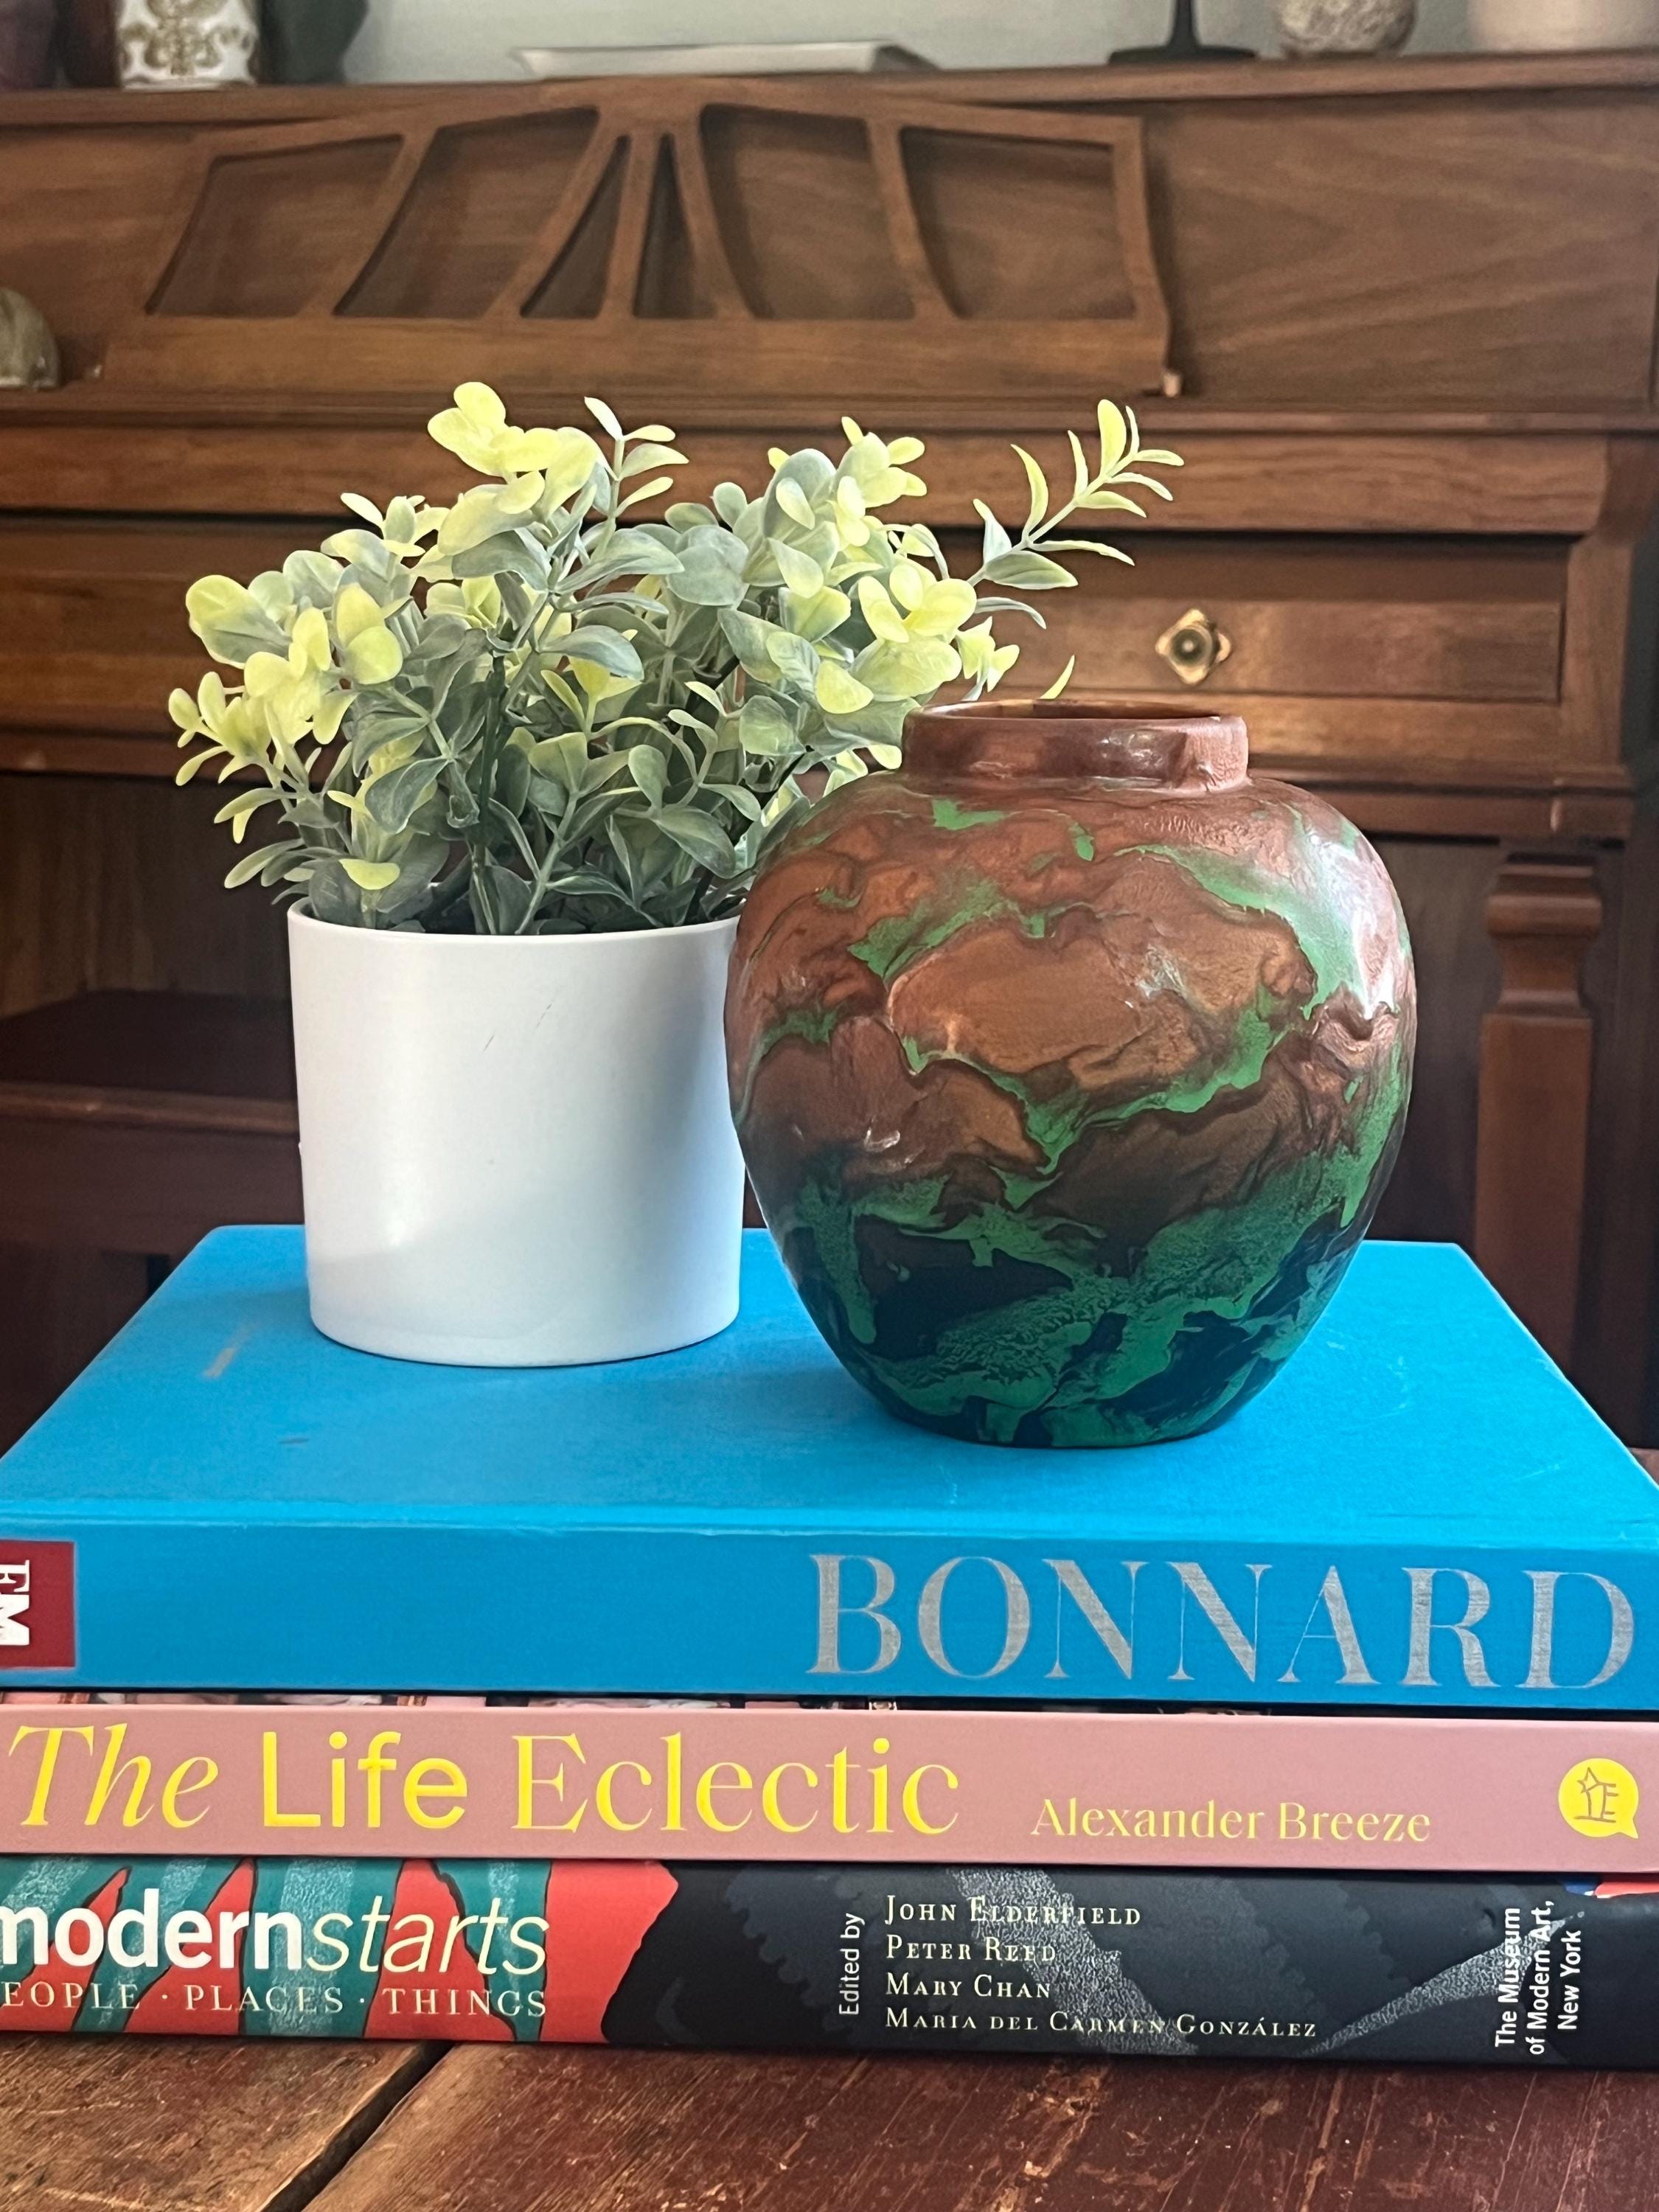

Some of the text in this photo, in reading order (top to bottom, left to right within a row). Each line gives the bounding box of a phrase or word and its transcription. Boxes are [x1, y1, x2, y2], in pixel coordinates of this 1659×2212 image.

[806, 1553, 1635, 1689] BONNARD
[7, 1723, 959, 1834] The Life Eclectic
[1030, 1799, 1431, 1842] Alexander Breeze
[0, 1888, 550, 1975] modernstarts
[885, 1895, 1141, 1925] JOHN ELDERFIELD
[886, 1934, 1057, 1962] PETER REED
[0, 1980, 547, 2017] EOPLE PLACES THINGS
[838, 1913, 866, 2015] Edited by
[886, 1972, 1051, 2000] MARY CHAN
[1495, 1908, 1521, 2048] The Museum
[1526, 1900, 1554, 2055] of Modern Art,
[1557, 1930, 1582, 2030] New York
[886, 2008, 1317, 2039] MARIA DEL CARMEN GONZÁLEZ
